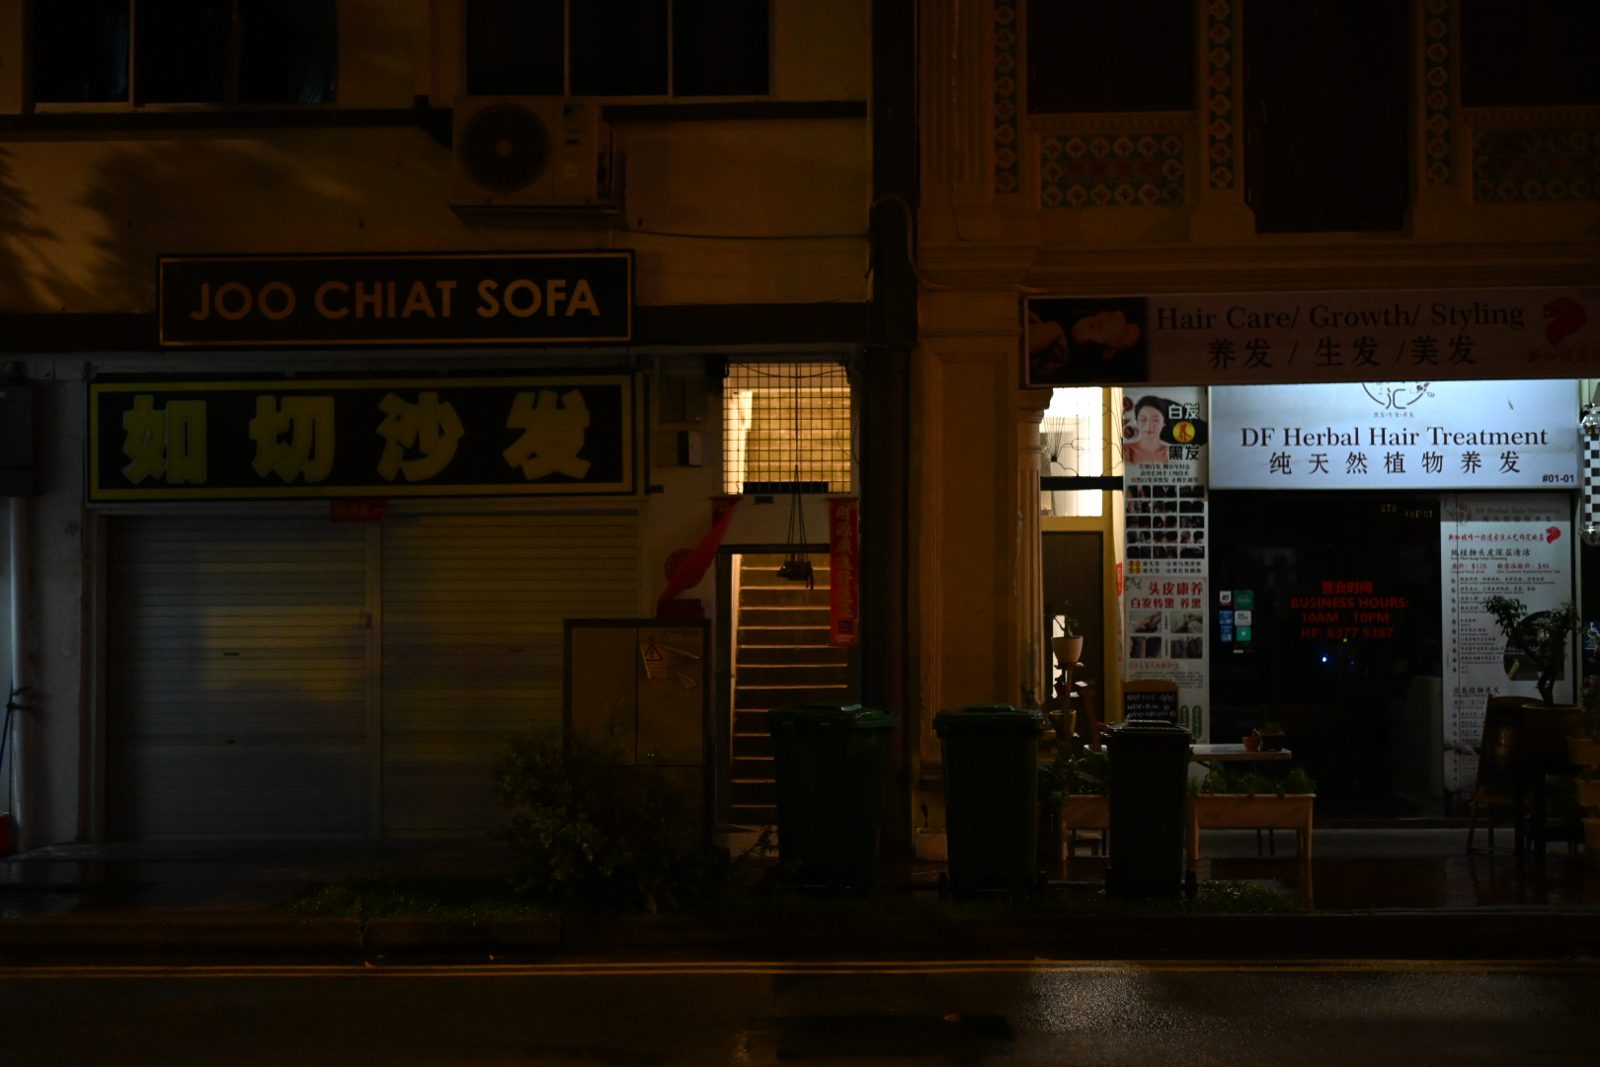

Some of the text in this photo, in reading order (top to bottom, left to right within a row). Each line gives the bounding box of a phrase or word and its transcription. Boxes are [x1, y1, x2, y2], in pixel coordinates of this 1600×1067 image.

[191, 278, 600, 321] JOO CHIAT SOFA
[1156, 302, 1526, 331] Hair Care/ Growth/ Styling
[1207, 337, 1273, 370] 养发
[1313, 335, 1382, 369] 生发
[1167, 404, 1199, 420] 白发
[121, 388, 592, 486] 如切沙发
[1240, 425, 1549, 447] DF Herbal Hair Treatment
[1168, 445, 1200, 461] 黑发
[1268, 450, 1522, 476] 纯天然植物养发
[1541, 473, 1576, 484] #01-01
[1290, 597, 1354, 609] BUSINESS
[1300, 611, 1339, 624] 10AM
[1352, 611, 1390, 624] 10PM
